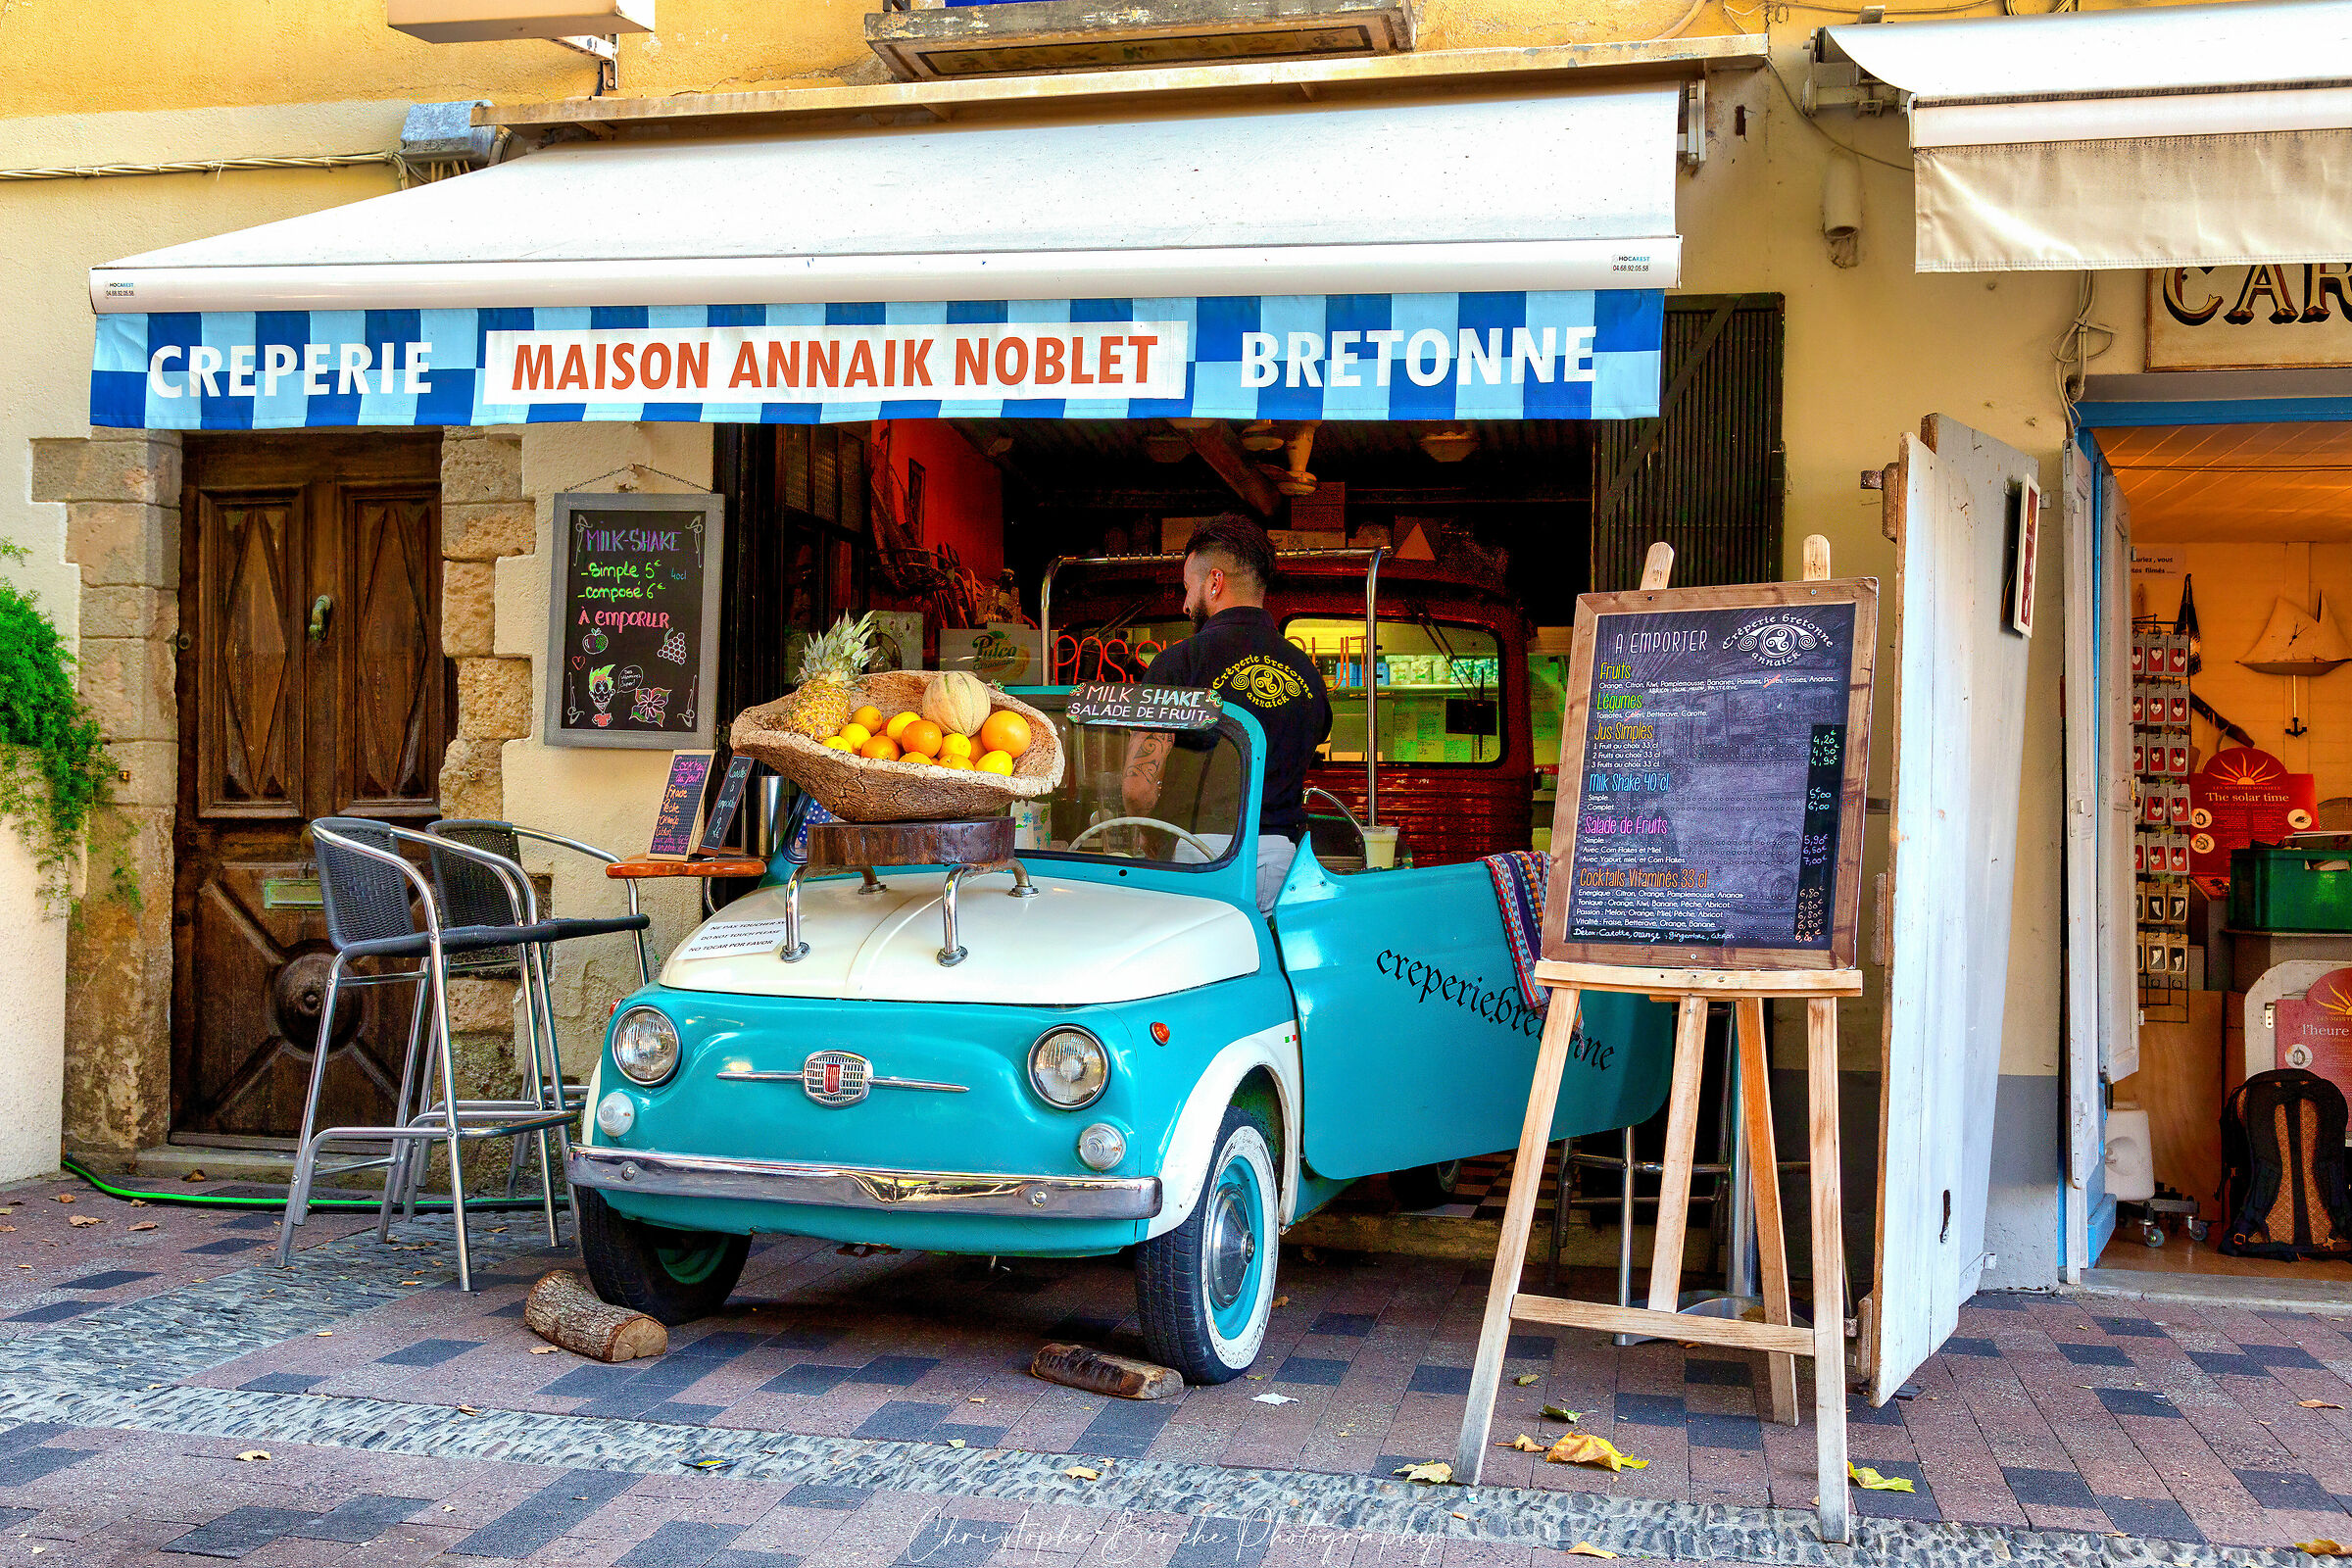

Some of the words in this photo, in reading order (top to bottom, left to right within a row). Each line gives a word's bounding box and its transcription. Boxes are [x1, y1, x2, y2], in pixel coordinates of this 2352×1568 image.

[512, 341, 710, 392] MAISON
[727, 337, 935, 390] ANNAIK
[955, 334, 1159, 388] NOBLET
[1240, 325, 1597, 388] BRETONNE
[150, 341, 433, 399] CREPERIE
[1615, 633, 1624, 654] A
[1630, 629, 1708, 654] EMPORTER
[1722, 615, 1777, 650] Crêperie
[972, 635, 1017, 659] Pulco
[1751, 649, 1802, 667] annaick
[1599, 662, 1632, 680] Fruits
[1086, 686, 1134, 703] MILK
[1140, 688, 1205, 708] SHAKE
[1596, 692, 1643, 712] Légumes
[1070, 703, 1131, 717] SALADE
[1136, 706, 1155, 718] DE
[1158, 707, 1206, 722] FRUIT
[1594, 722, 1612, 740] Jus
[1615, 720, 1653, 743] Simples
[1589, 773, 1609, 792] Milk
[1612, 772, 1641, 792] Shake
[1643, 772, 1657, 791] 40
[1659, 772, 1670, 792] cl
[1587, 803, 1615, 811] Complet
[1588, 794, 1609, 803] Simple
[2205, 792, 2230, 802] The
[2231, 792, 2261, 802] solar
[2263, 792, 2290, 802] time
[1585, 815, 1617, 834] Salade
[1620, 815, 1633, 834] de
[1635, 815, 1668, 834] Fruits
[1584, 836, 1605, 845] Simple
[1580, 867, 1626, 887] Cocktails
[1629, 868, 1678, 888] Vitaminés
[1681, 868, 1695, 888] 33
[1697, 869, 1708, 888] cl
[2302, 1023, 2350, 1036] l'heure
